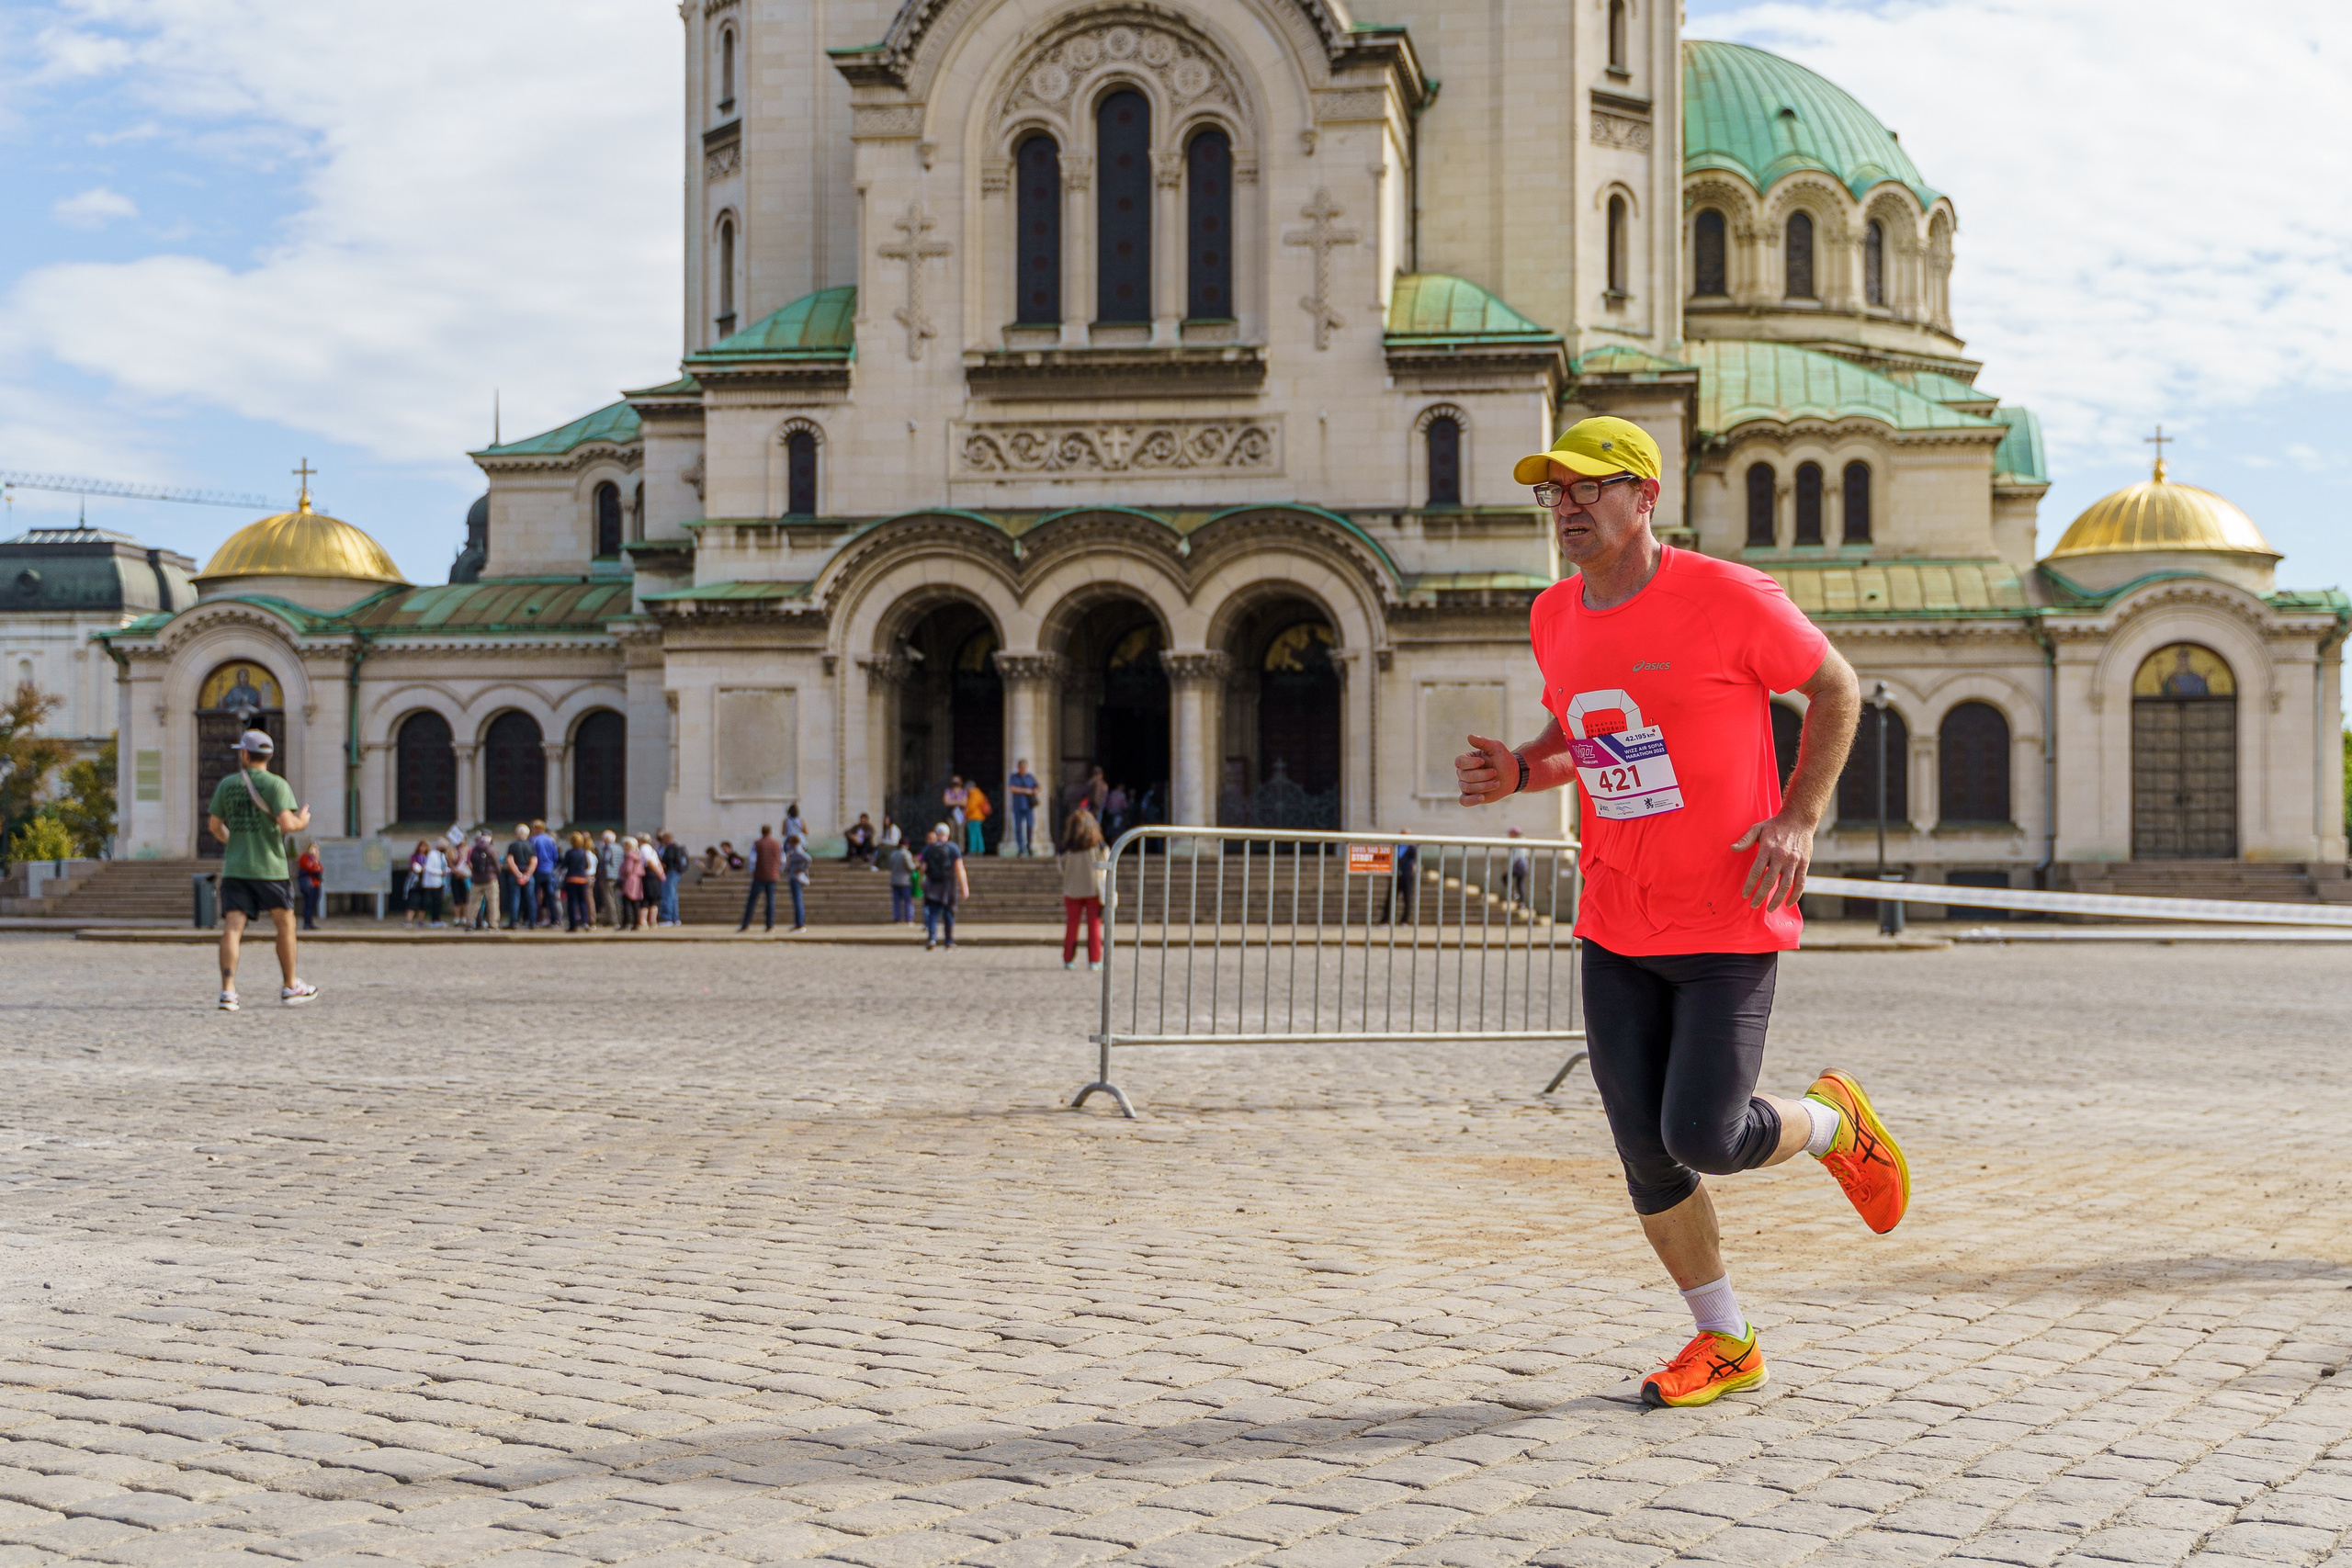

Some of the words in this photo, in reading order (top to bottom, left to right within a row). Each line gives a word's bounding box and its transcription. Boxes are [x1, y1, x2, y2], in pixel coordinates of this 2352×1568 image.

[1587, 726, 1625, 734] FRIENDSHIP
[1625, 733, 1647, 741] 42.195
[1625, 750, 1653, 760] MARATHON
[1600, 764, 1642, 792] 421
